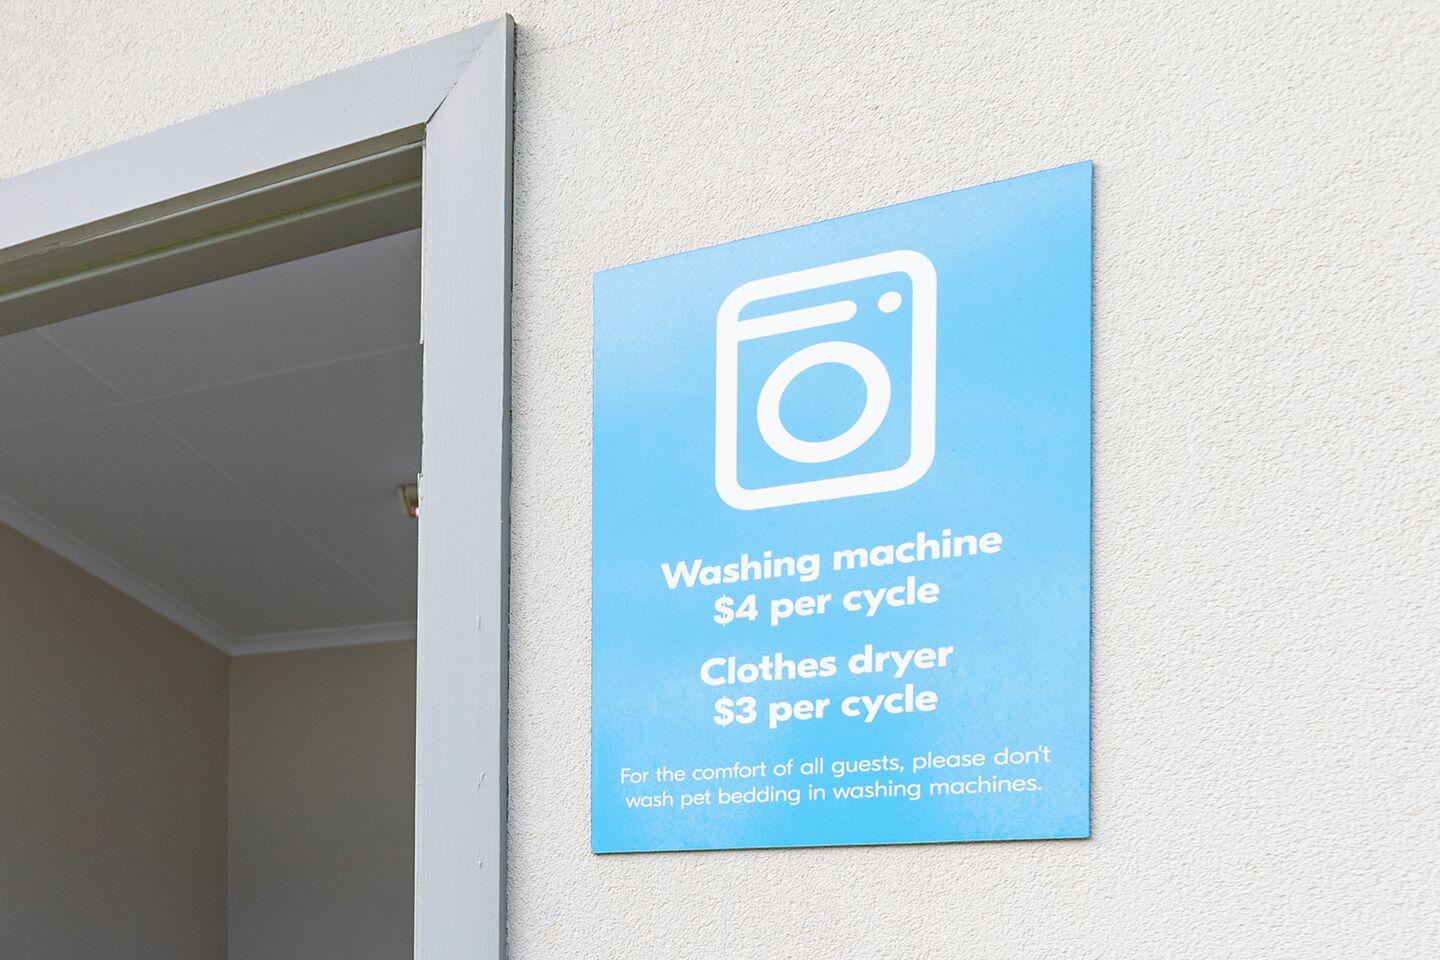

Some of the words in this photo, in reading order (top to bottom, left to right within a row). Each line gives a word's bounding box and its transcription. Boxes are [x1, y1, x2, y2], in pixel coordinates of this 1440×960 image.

[660, 550, 820, 590] Washing
[833, 528, 1003, 571] machine
[713, 594, 758, 625] $4
[770, 593, 831, 626] per
[842, 575, 940, 617] cycle
[700, 652, 837, 686] Clothes
[848, 644, 953, 679] dryer
[713, 695, 758, 727] $3
[769, 698, 830, 729] per
[841, 683, 938, 723] cycle
[620, 767, 649, 784] For
[655, 766, 686, 782] the
[692, 760, 767, 781] comfort
[773, 759, 793, 776] of
[800, 757, 824, 775] all
[831, 755, 905, 778] guests,
[913, 751, 986, 774] please
[993, 745, 1051, 766] don't
[625, 791, 674, 809] wash
[680, 788, 712, 811] pet
[718, 785, 801, 806] bedding
[808, 784, 825, 800] in
[833, 781, 921, 801] washing
[929, 775, 1042, 796] machines.
